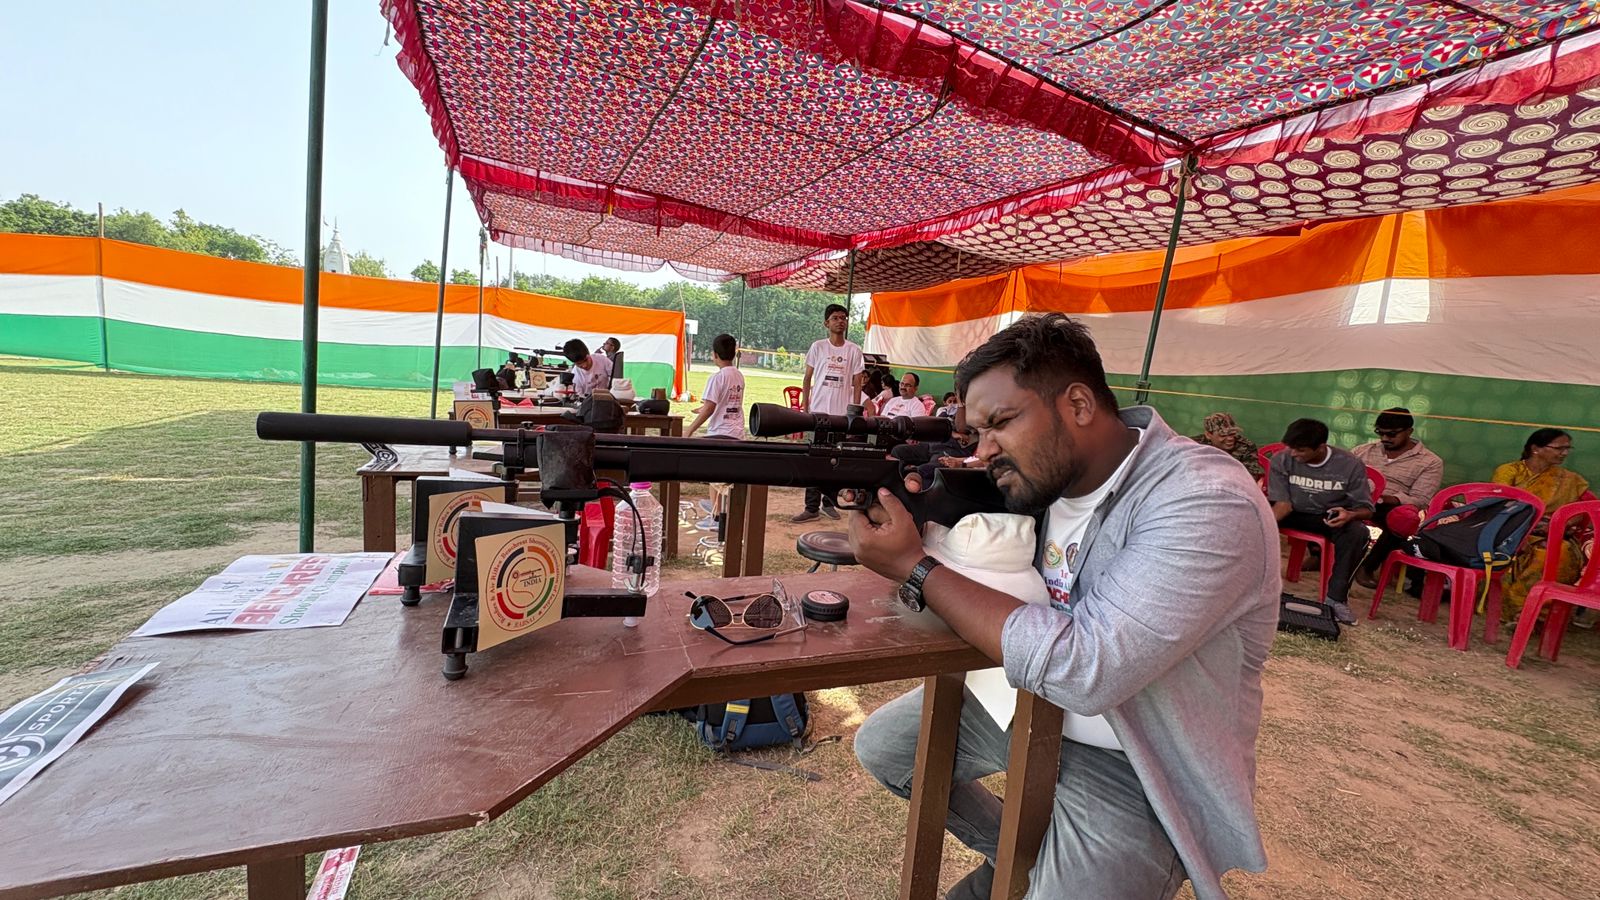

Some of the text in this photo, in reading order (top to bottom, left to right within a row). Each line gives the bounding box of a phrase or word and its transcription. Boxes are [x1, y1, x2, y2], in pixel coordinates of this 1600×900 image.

[492, 560, 502, 581] Rifles
[501, 540, 527, 558] Benchrest
[523, 577, 542, 588] INDIA
[200, 608, 236, 625] All
